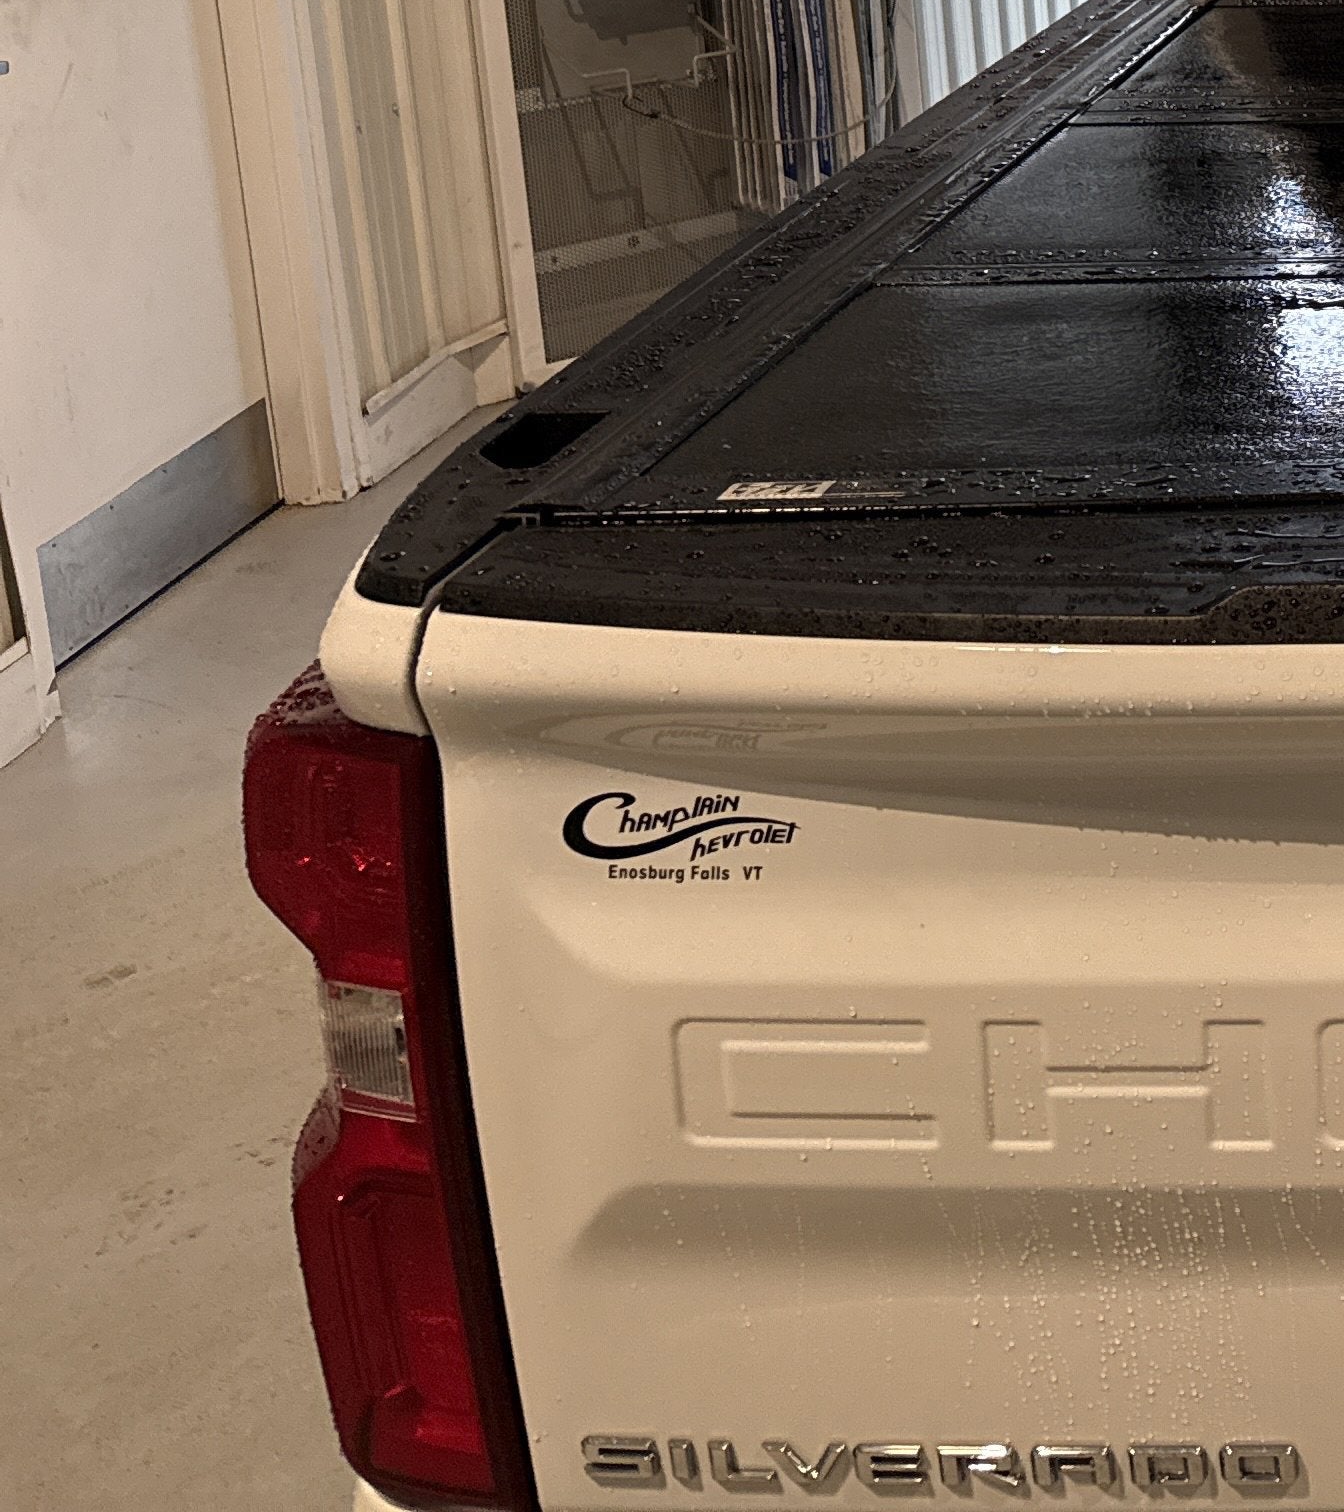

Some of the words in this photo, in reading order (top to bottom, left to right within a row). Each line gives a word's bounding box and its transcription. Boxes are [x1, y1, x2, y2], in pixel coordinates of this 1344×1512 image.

[608, 864, 685, 883] Enosburg
[690, 865, 730, 881] Falls
[743, 865, 763, 881] VT
[581, 1434, 1302, 1488] SILVERADO
